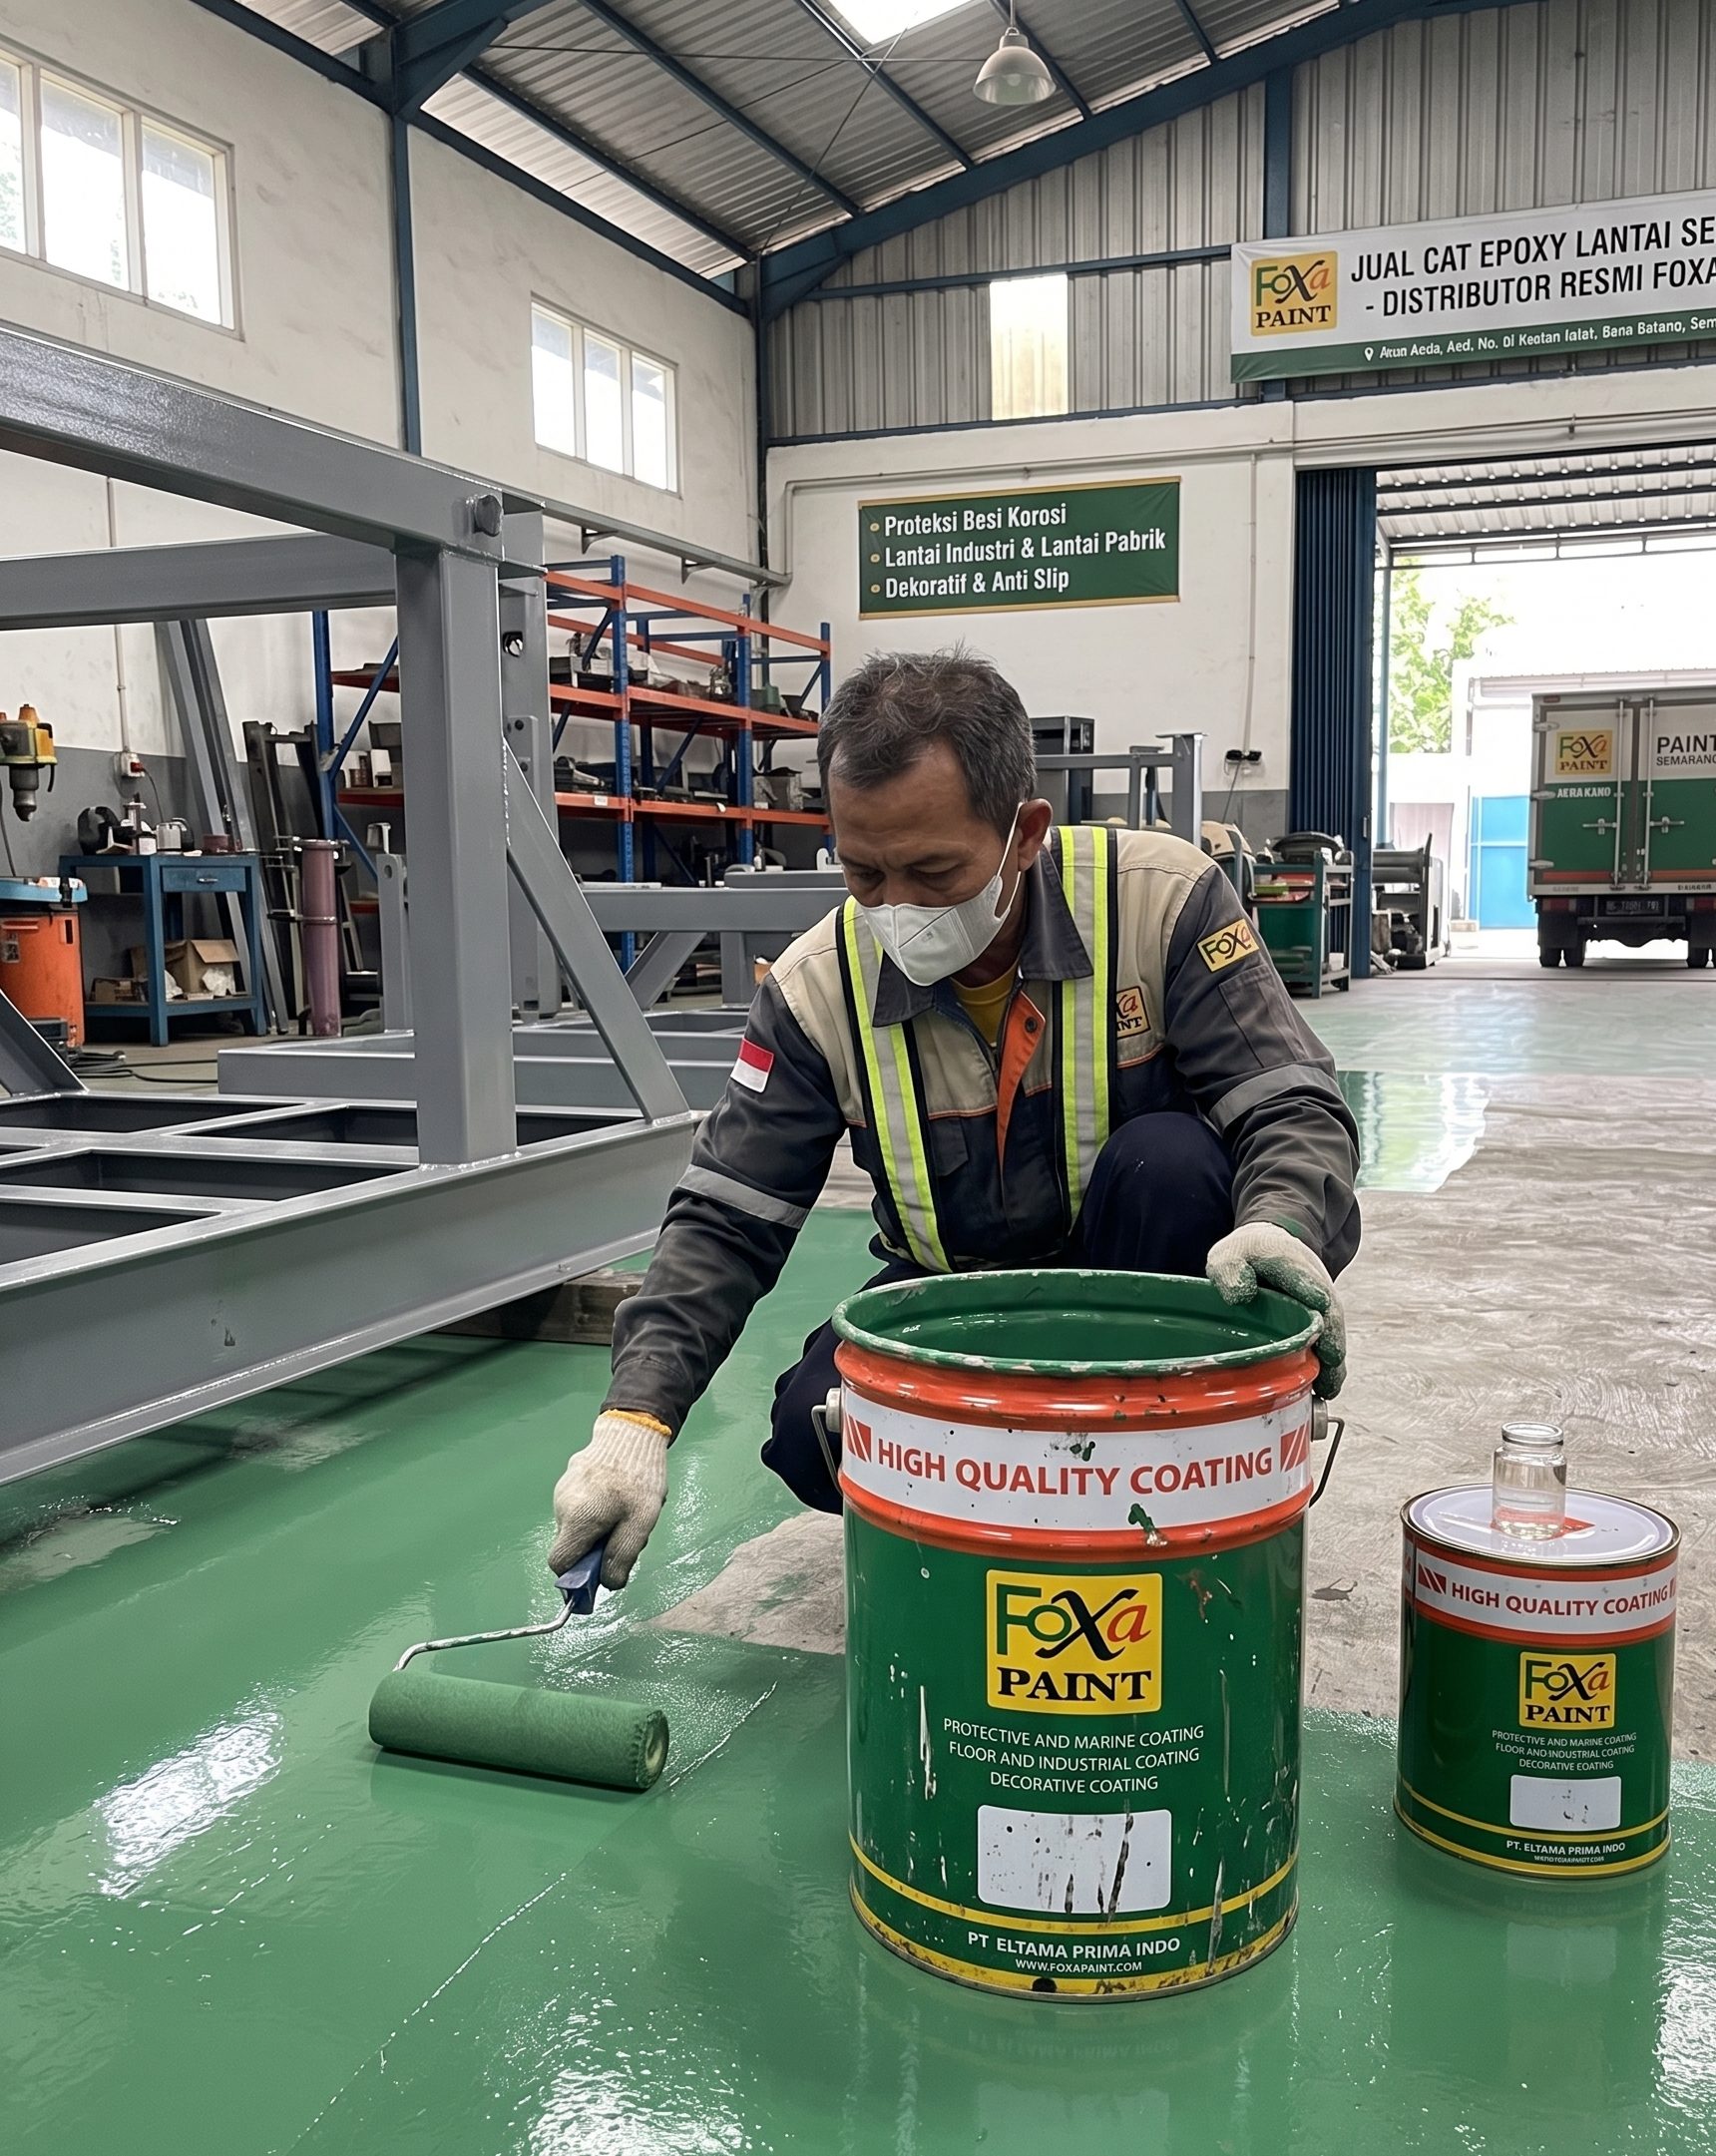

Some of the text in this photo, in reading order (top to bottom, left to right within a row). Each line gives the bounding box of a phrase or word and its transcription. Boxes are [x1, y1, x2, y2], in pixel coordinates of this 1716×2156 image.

[1351, 216, 1715, 282] JUAL CAT EPOXY LANTAI SE
[1384, 273, 1550, 316] DISTRIBUTOR
[1560, 264, 1642, 297] RESMI
[1256, 305, 1331, 328] PAINT
[1478, 337, 1498, 350] No.
[885, 503, 1067, 537] Proteksi Besi Korosi
[885, 528, 1166, 568] Lantai Industri & Lantai Pabrik
[885, 568, 1070, 599] Dekoratif & Anti Slip
[1559, 760, 1607, 770] PAINT
[878, 1438, 1272, 1496] HIGH QUALITY COATING
[1453, 1582, 1668, 1616] HIGH QUALITY COATING
[997, 1666, 1152, 1702] PAINT
[1525, 1704, 1610, 1724] PAINT
[944, 1718, 1204, 1749] PROTECTIVE AND MARINE COATING
[1492, 1730, 1637, 1747] PROTECTIVE AND MARINE COATING
[949, 1742, 1199, 1771] FLOOR AND INDUSTRIAL COATING
[1496, 1743, 1524, 1755] FLOOR
[1548, 1749, 1600, 1759] INDUSTRIAL
[1601, 1744, 1635, 1757] COATING
[1518, 1758, 1574, 1771] DECORATIVE
[991, 1771, 1158, 1794] DECORATIVE COATING
[1506, 1840, 1626, 1856] PT. ELTAMA PRIMA INDO
[968, 1932, 1180, 1959] PT ELTAMA PRIMA INDO
[1016, 1958, 1142, 1973] WWW.FOXAPAINT.COM
